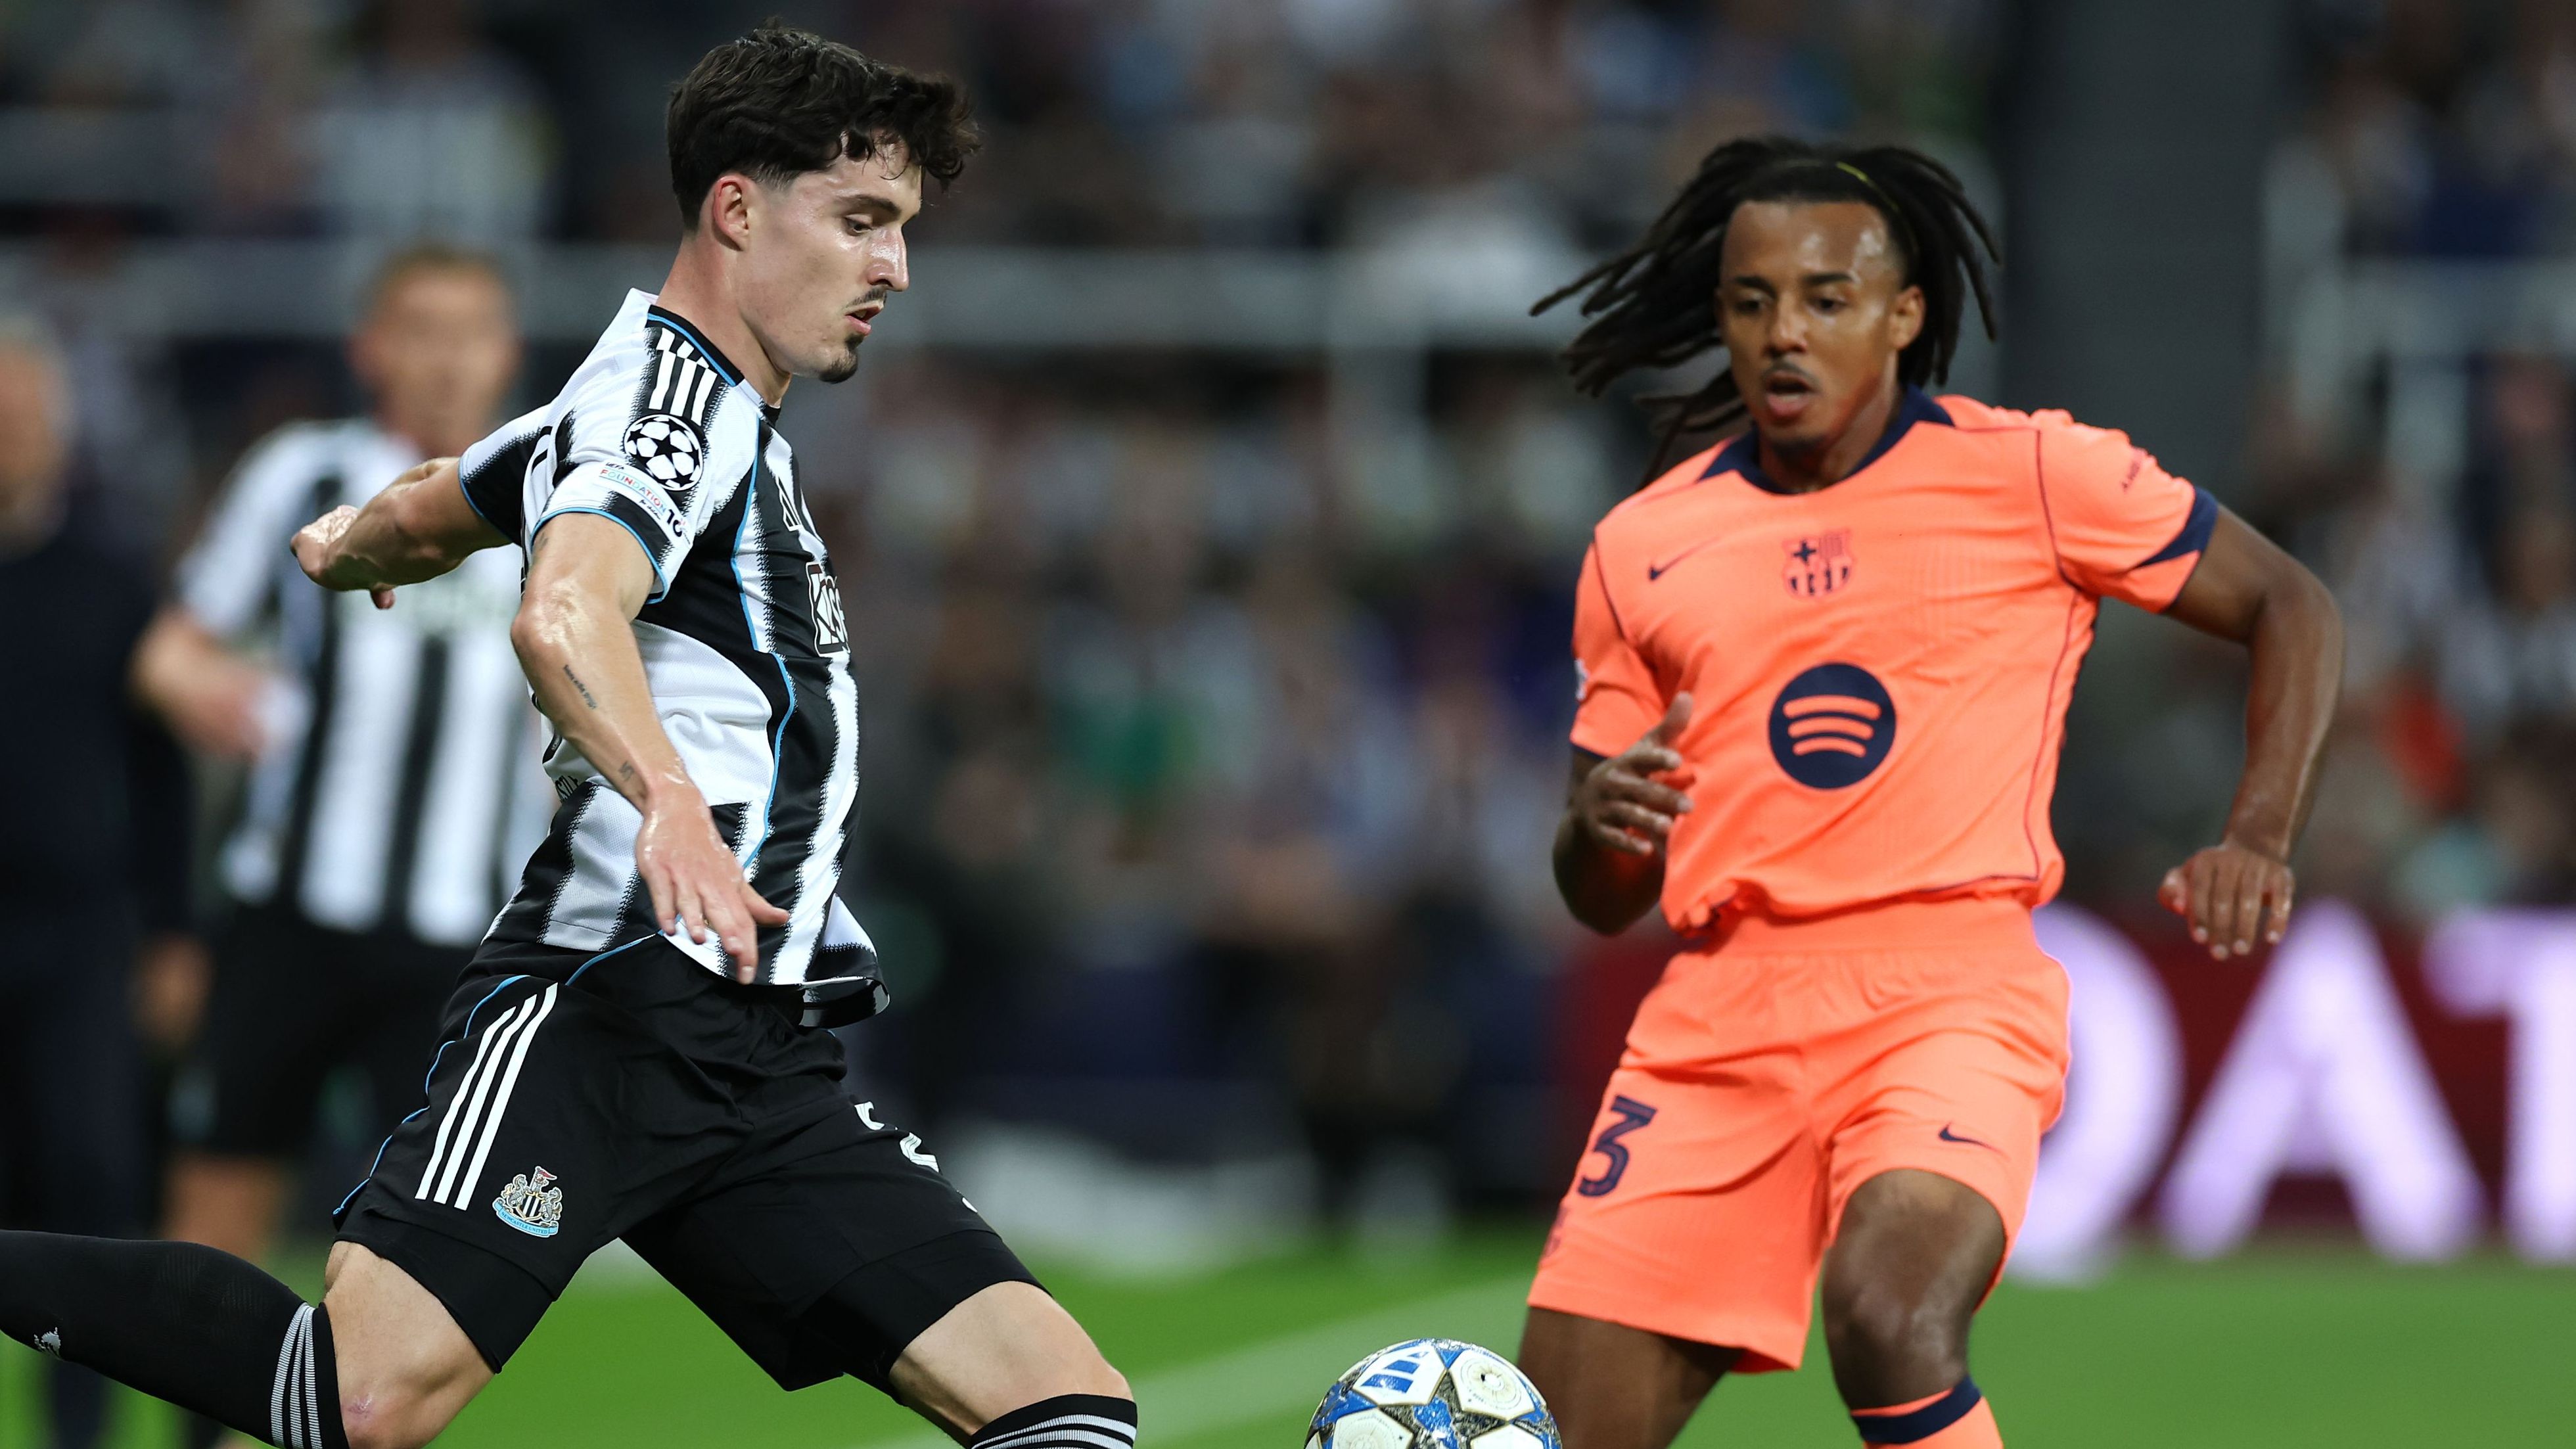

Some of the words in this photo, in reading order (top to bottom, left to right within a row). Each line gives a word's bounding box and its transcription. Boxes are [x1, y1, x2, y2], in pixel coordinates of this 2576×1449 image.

[600, 469, 666, 513] FOUNDATION
[1578, 1094, 1657, 1197] 3
[501, 1212, 528, 1229] NEWCASTLE
